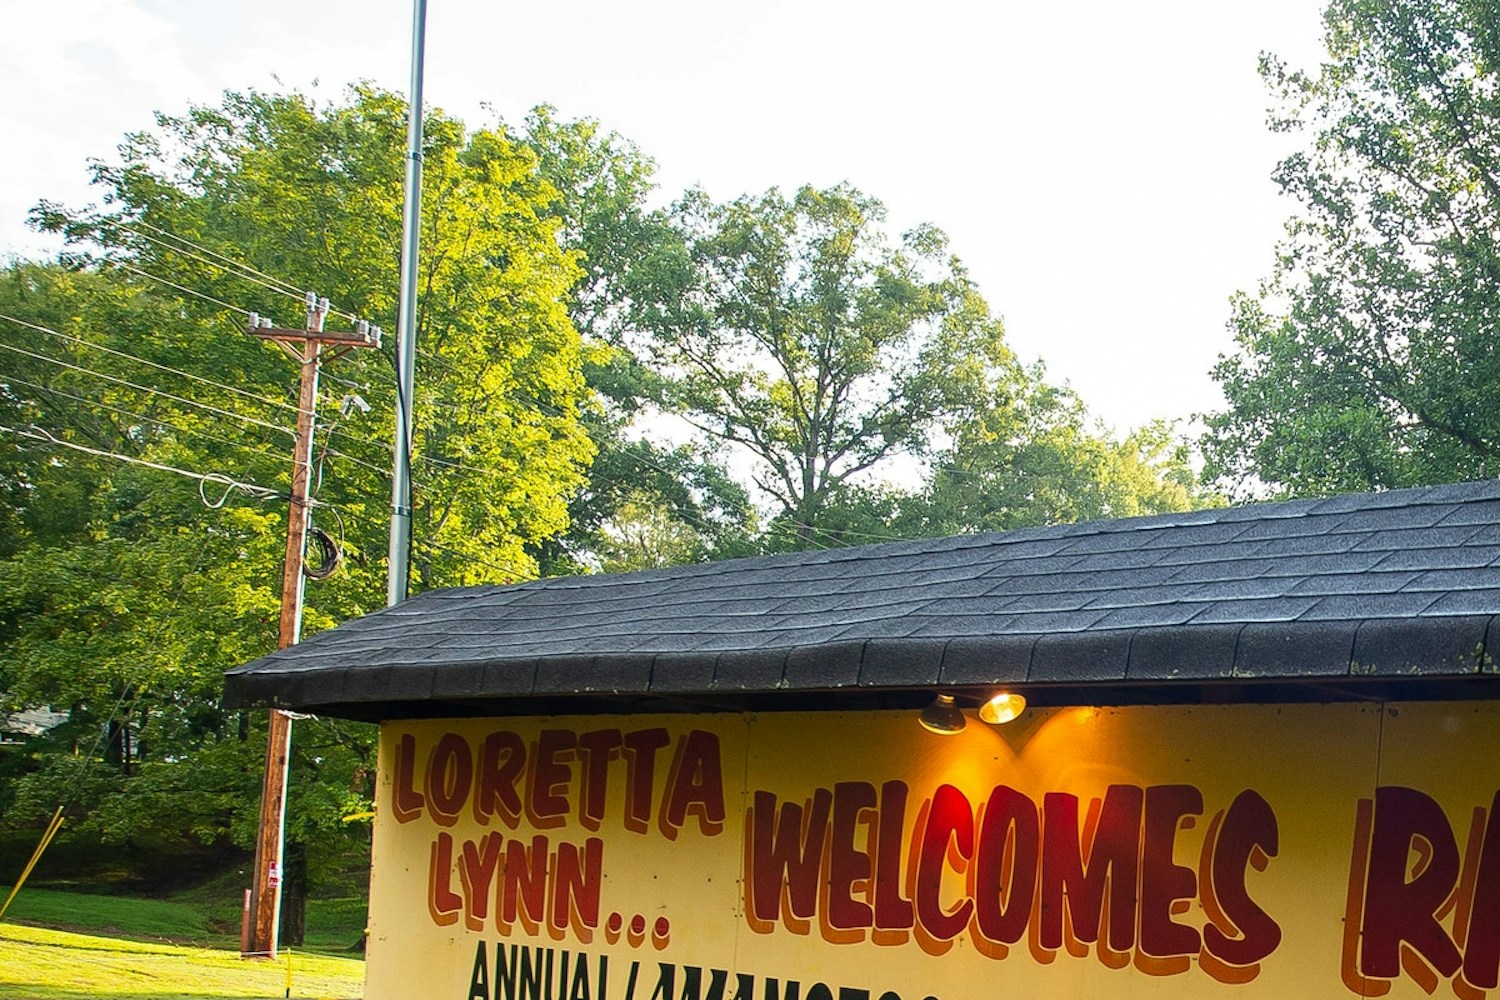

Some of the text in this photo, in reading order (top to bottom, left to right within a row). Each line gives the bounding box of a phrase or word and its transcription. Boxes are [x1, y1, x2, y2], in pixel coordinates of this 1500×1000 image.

[391, 729, 726, 841] LORETTA
[428, 830, 671, 950] LYNN...
[744, 780, 1283, 984] WELCOMES
